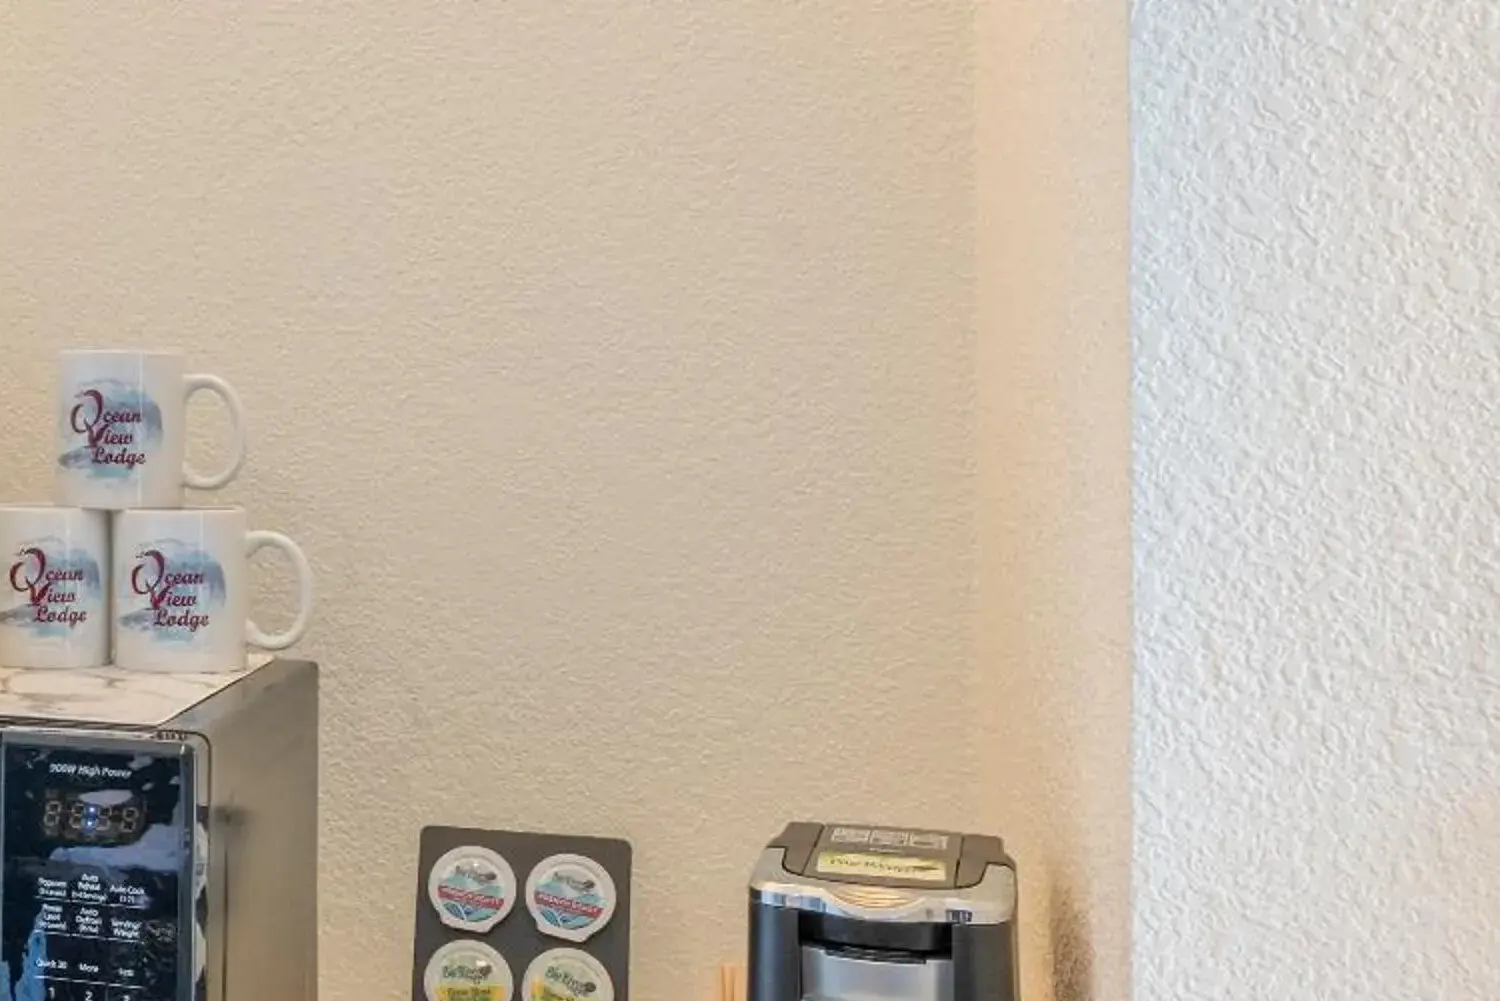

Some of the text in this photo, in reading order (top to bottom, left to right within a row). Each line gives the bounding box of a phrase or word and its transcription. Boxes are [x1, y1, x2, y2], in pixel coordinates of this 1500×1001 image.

[70, 389, 142, 433] Ocean
[85, 421, 134, 449] View
[91, 448, 146, 468] Lodge
[10, 547, 84, 592] Ocean
[132, 550, 205, 595] Ocean
[29, 578, 75, 606] View
[147, 582, 197, 610] View
[33, 605, 88, 629] Lodge
[153, 609, 210, 632] Lodge
[78, 765, 100, 777] High
[102, 767, 132, 779] Power
[48, 986, 56, 1000] 1
